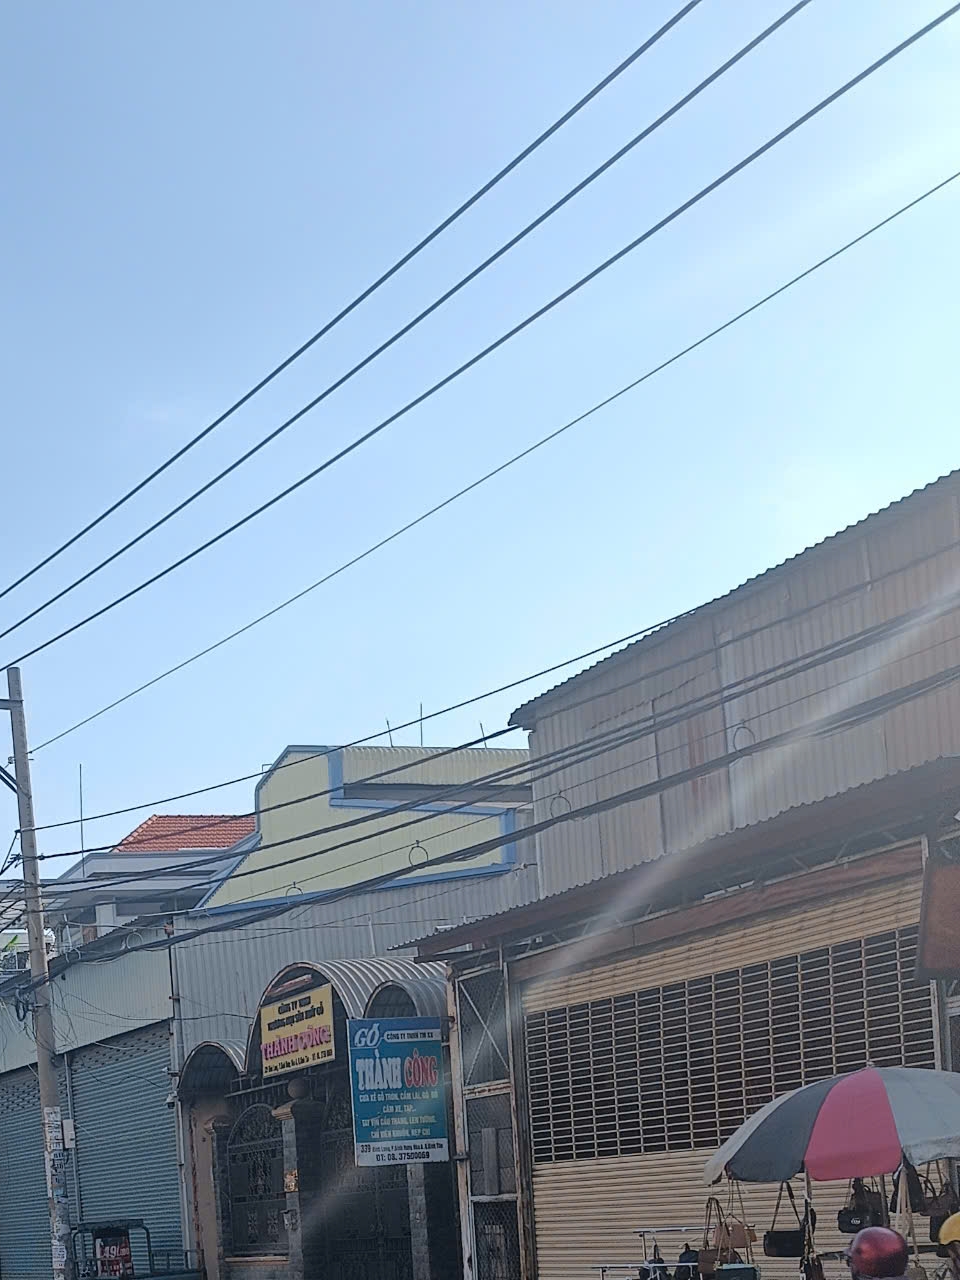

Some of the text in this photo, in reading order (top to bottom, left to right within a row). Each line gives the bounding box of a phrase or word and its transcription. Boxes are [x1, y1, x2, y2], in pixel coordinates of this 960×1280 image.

[354, 1023, 380, 1047] GỖ
[356, 1049, 402, 1090] THÀNH
[404, 1048, 438, 1088] CÔNG
